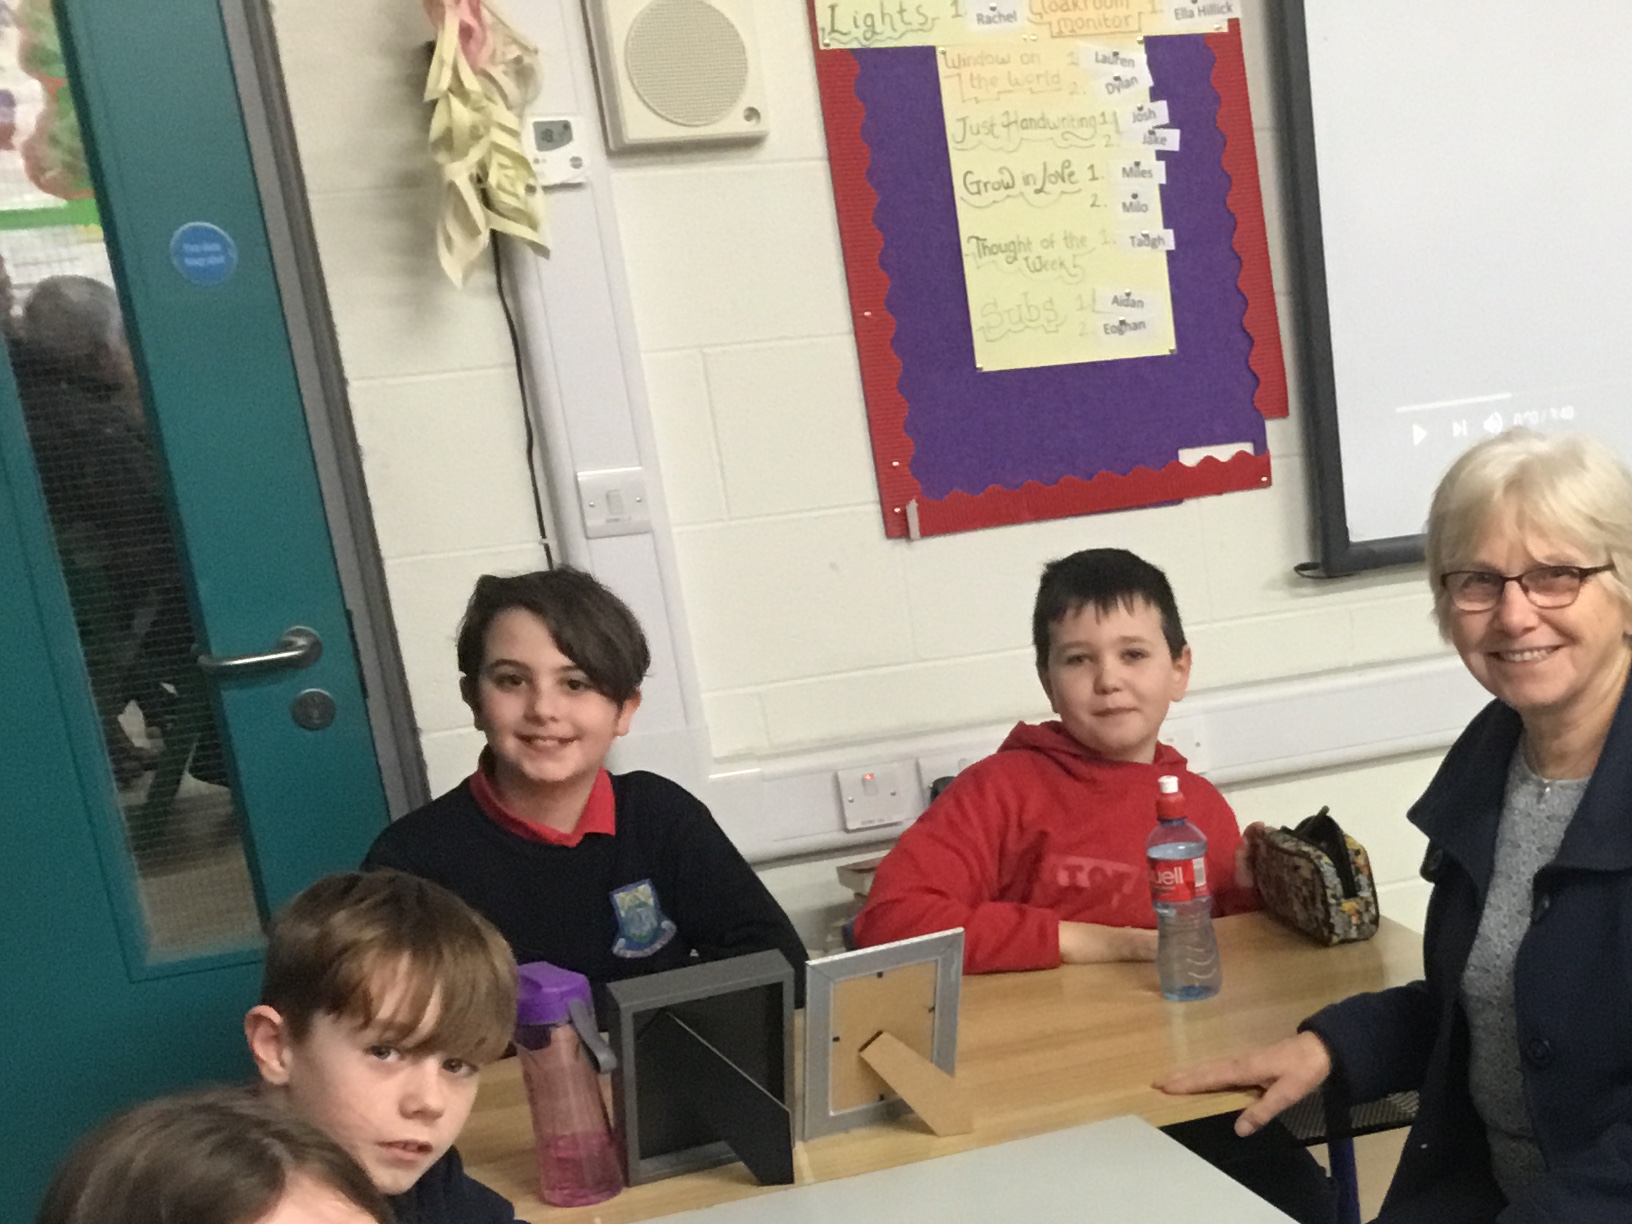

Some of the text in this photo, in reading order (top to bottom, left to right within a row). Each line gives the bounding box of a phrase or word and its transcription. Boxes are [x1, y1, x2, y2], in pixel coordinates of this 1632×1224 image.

[828, 0, 929, 41] Lights
[976, 10, 1017, 25] Rachel
[1174, 8, 1194, 20] Ella
[1094, 51, 1136, 68] Lauren
[1105, 74, 1140, 95] Dylan
[1131, 109, 1157, 123] Josh
[953, 112, 1000, 144] Just
[1141, 133, 1168, 146] Jake
[1121, 165, 1154, 179] Miles
[962, 166, 1016, 196] Grow
[1022, 170, 1037, 186] in
[1121, 200, 1150, 214] Milo
[966, 234, 1033, 265] Thought
[1039, 232, 1055, 250] of
[1063, 229, 1088, 249] the
[1110, 294, 1145, 310] Aidan
